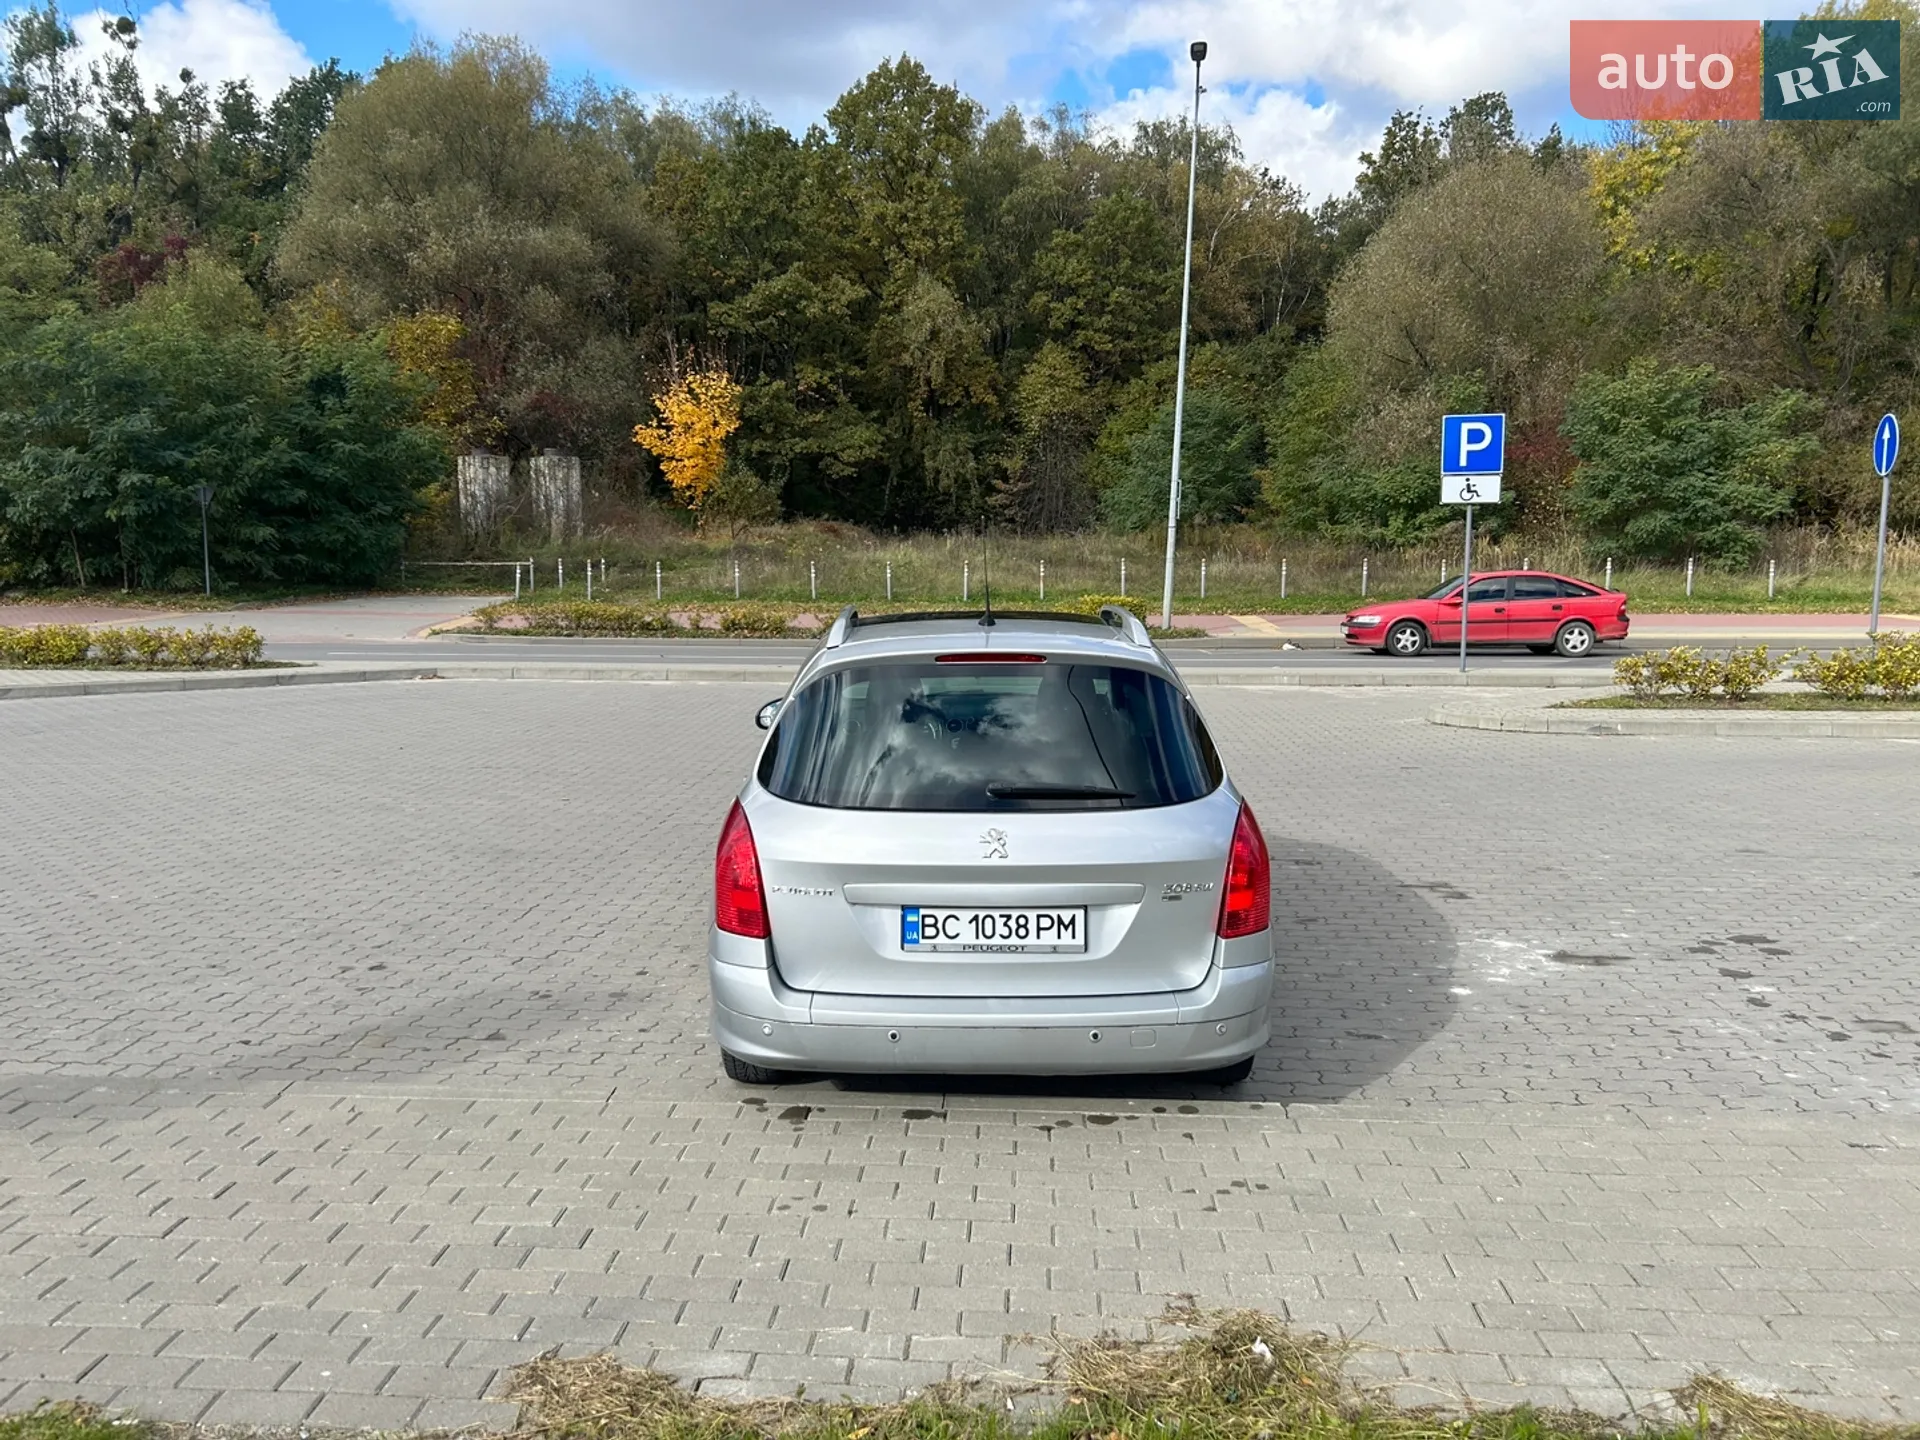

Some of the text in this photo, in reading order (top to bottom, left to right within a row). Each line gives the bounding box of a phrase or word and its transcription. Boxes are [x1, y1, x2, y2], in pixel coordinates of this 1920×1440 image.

[1459, 422, 1492, 467] P
[906, 931, 919, 940] UA
[921, 914, 1076, 939] BC 1038 PM
